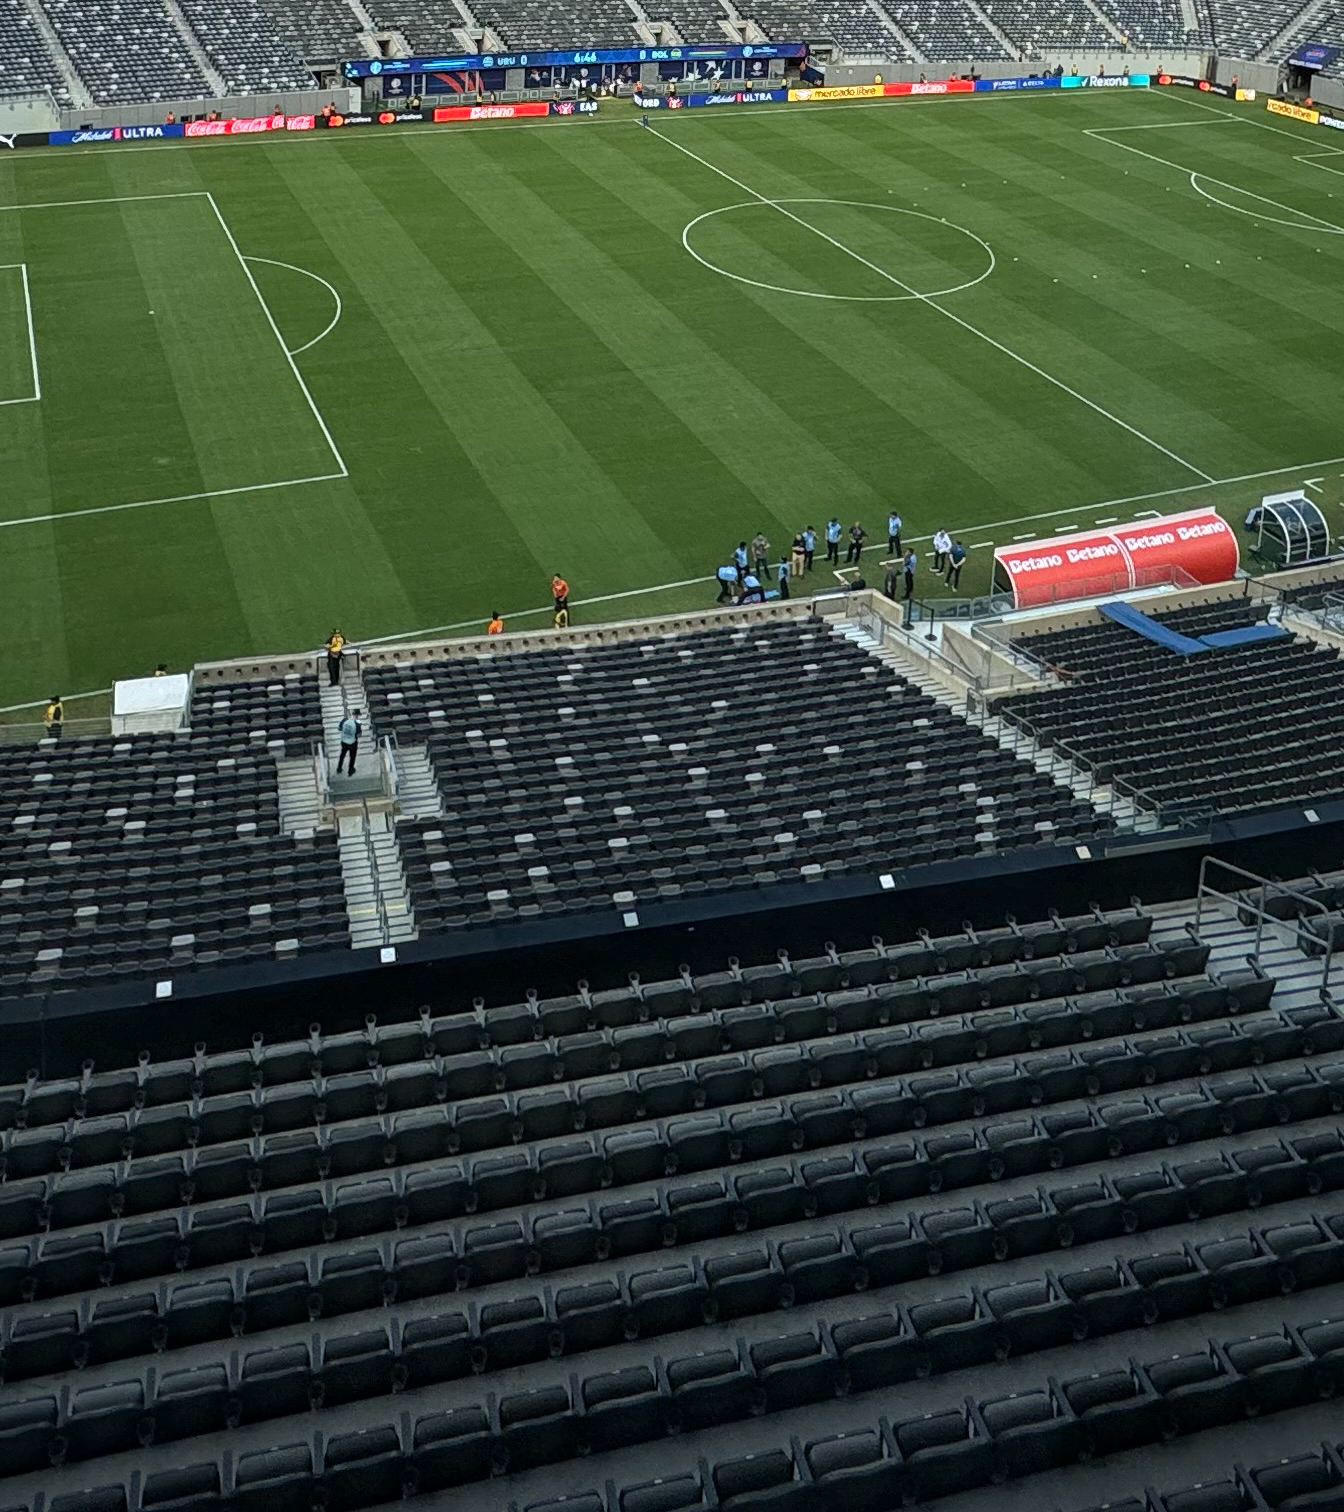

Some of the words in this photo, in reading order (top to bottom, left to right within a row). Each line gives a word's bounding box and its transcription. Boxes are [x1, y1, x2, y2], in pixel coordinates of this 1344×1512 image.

[1090, 76, 1129, 86] Rexona
[743, 93, 772, 101] ULTRA
[815, 88, 855, 97] mercado
[122, 127, 163, 138] ULTRA
[1009, 554, 1062, 574] Betano
[1066, 543, 1118, 563] Betano
[1125, 533, 1174, 551] Betano
[1176, 521, 1225, 540] Betano
